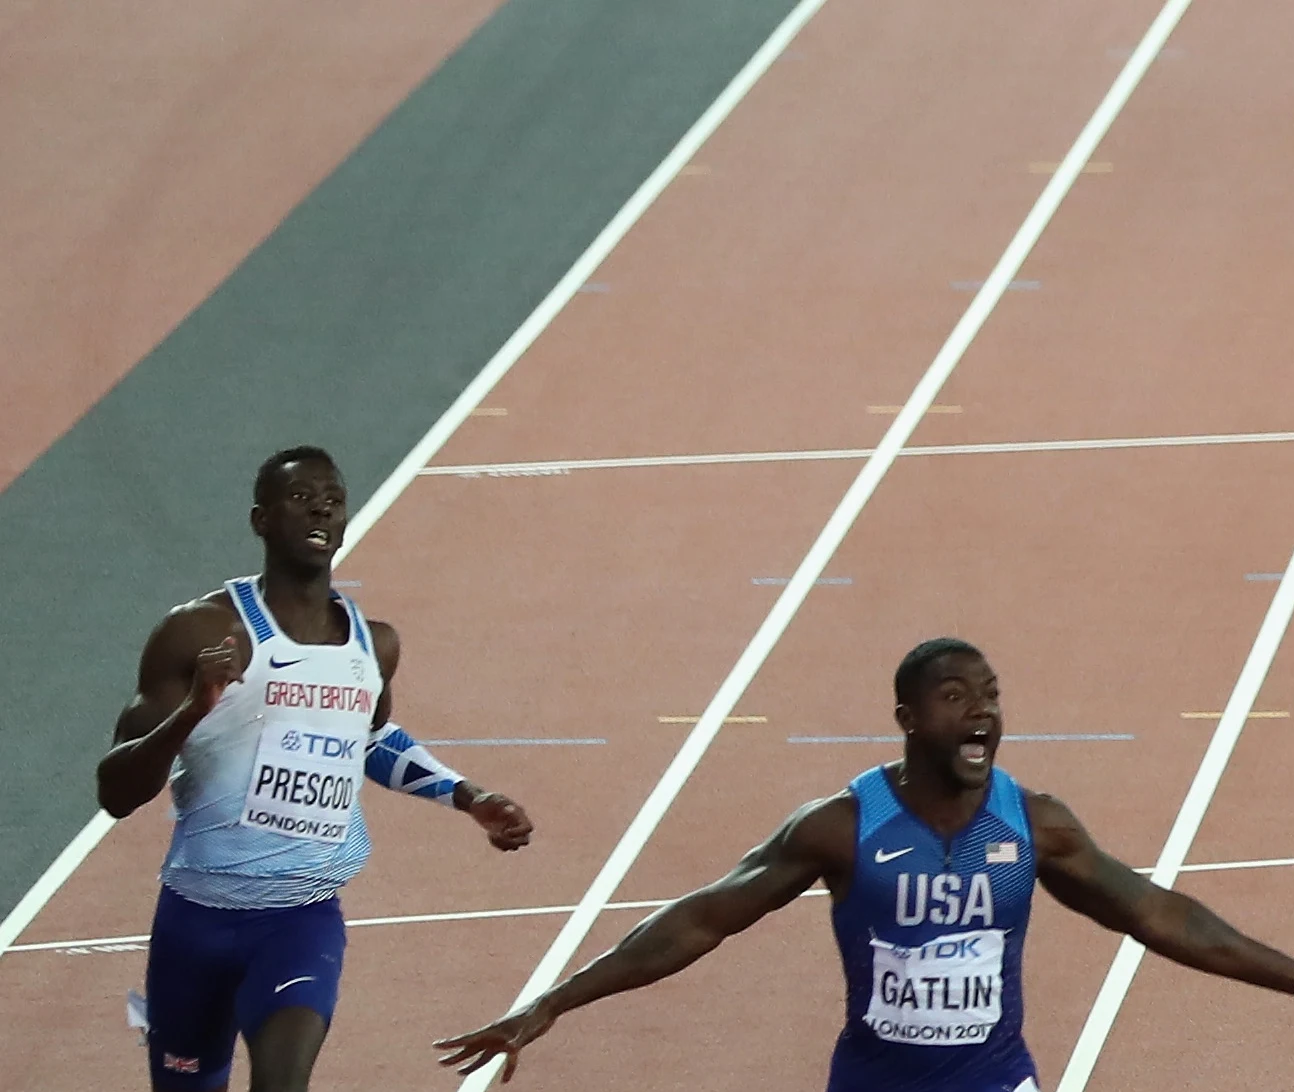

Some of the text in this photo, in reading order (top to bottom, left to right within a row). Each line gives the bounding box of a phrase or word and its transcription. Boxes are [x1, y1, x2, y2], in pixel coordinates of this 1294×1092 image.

[264, 681, 373, 715] GREAT BRITAIN
[302, 733, 359, 759] TDK
[247, 809, 346, 838] LONDON 201
[896, 872, 995, 927] USA
[881, 970, 993, 1011] GATLIN
